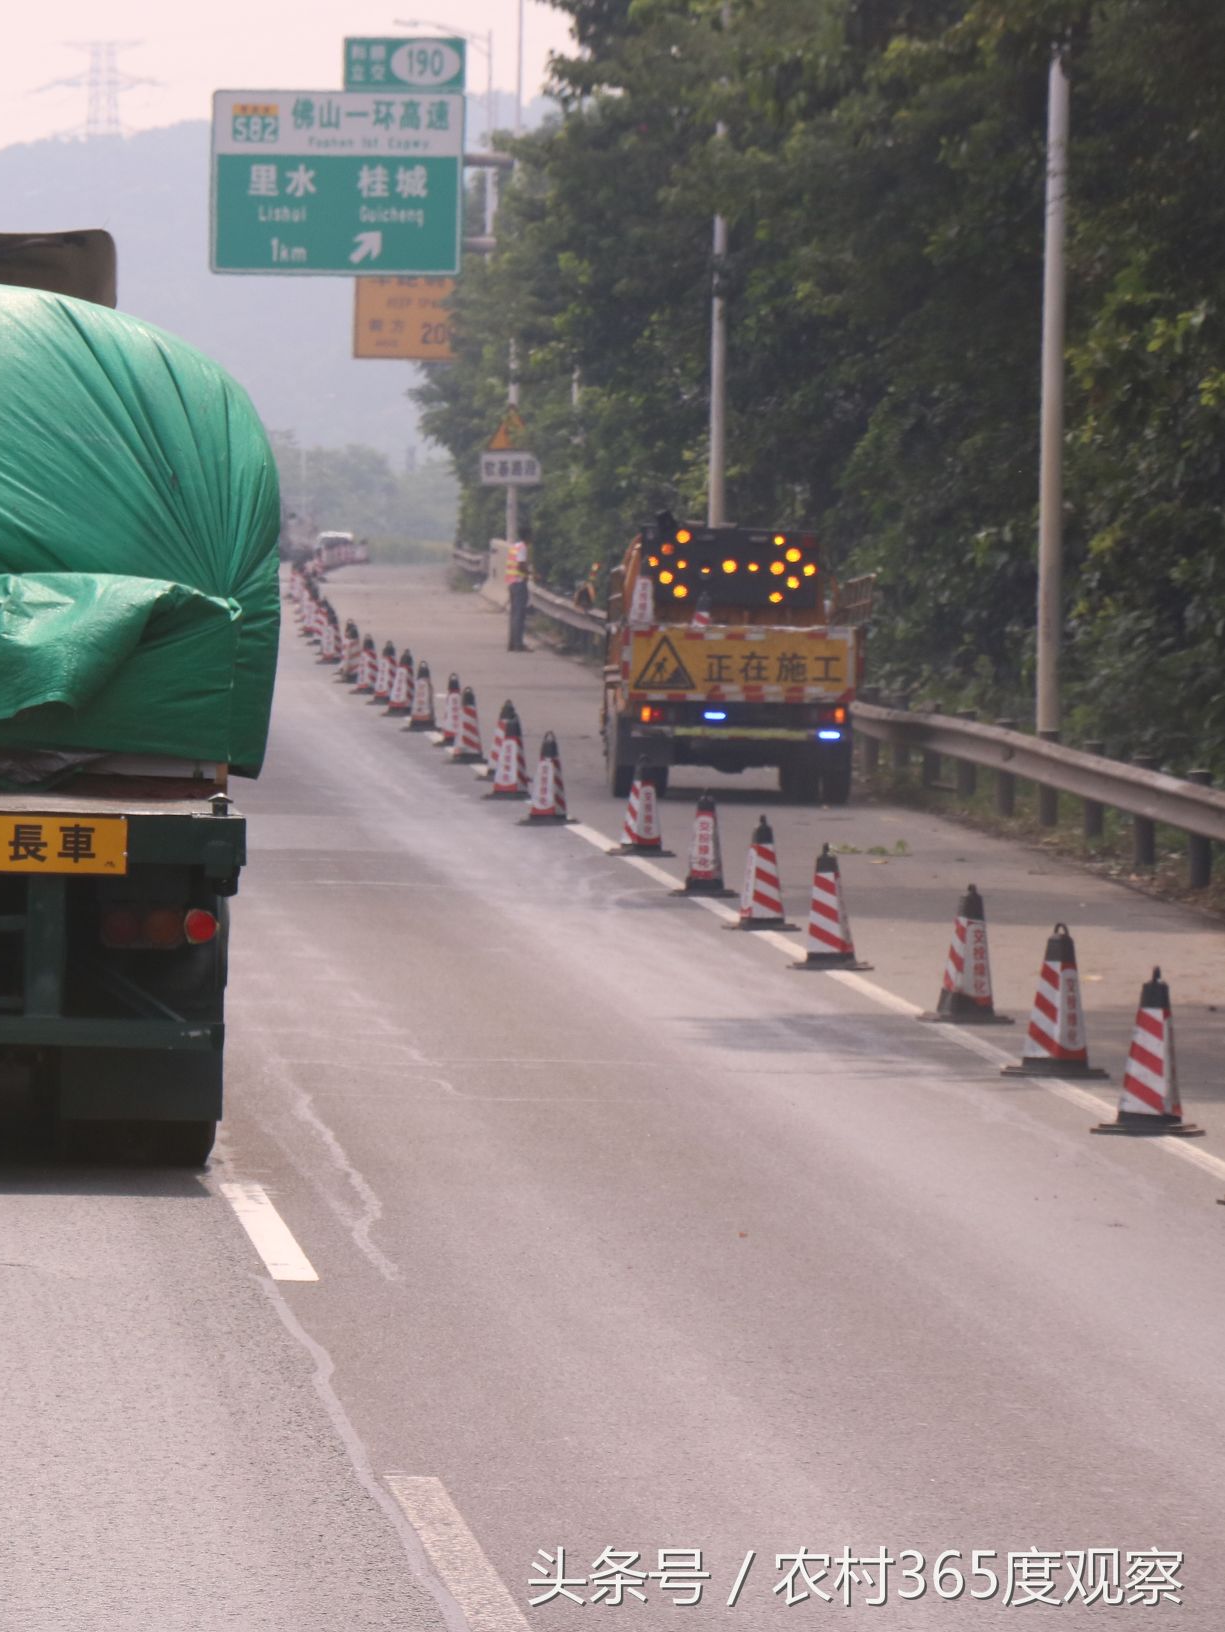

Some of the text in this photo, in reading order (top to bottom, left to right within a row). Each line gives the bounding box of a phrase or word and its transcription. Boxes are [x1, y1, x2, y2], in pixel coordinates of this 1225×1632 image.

[407, 49, 444, 76] 190
[233, 116, 278, 142] S82
[291, 98, 452, 131] 佛山一环高速
[248, 164, 429, 199] 里水 桂城
[259, 205, 424, 227] Lishui Guicheng
[270, 239, 307, 262] 1km
[703, 652, 842, 684] 正在施工
[8, 823, 97, 864] 長車
